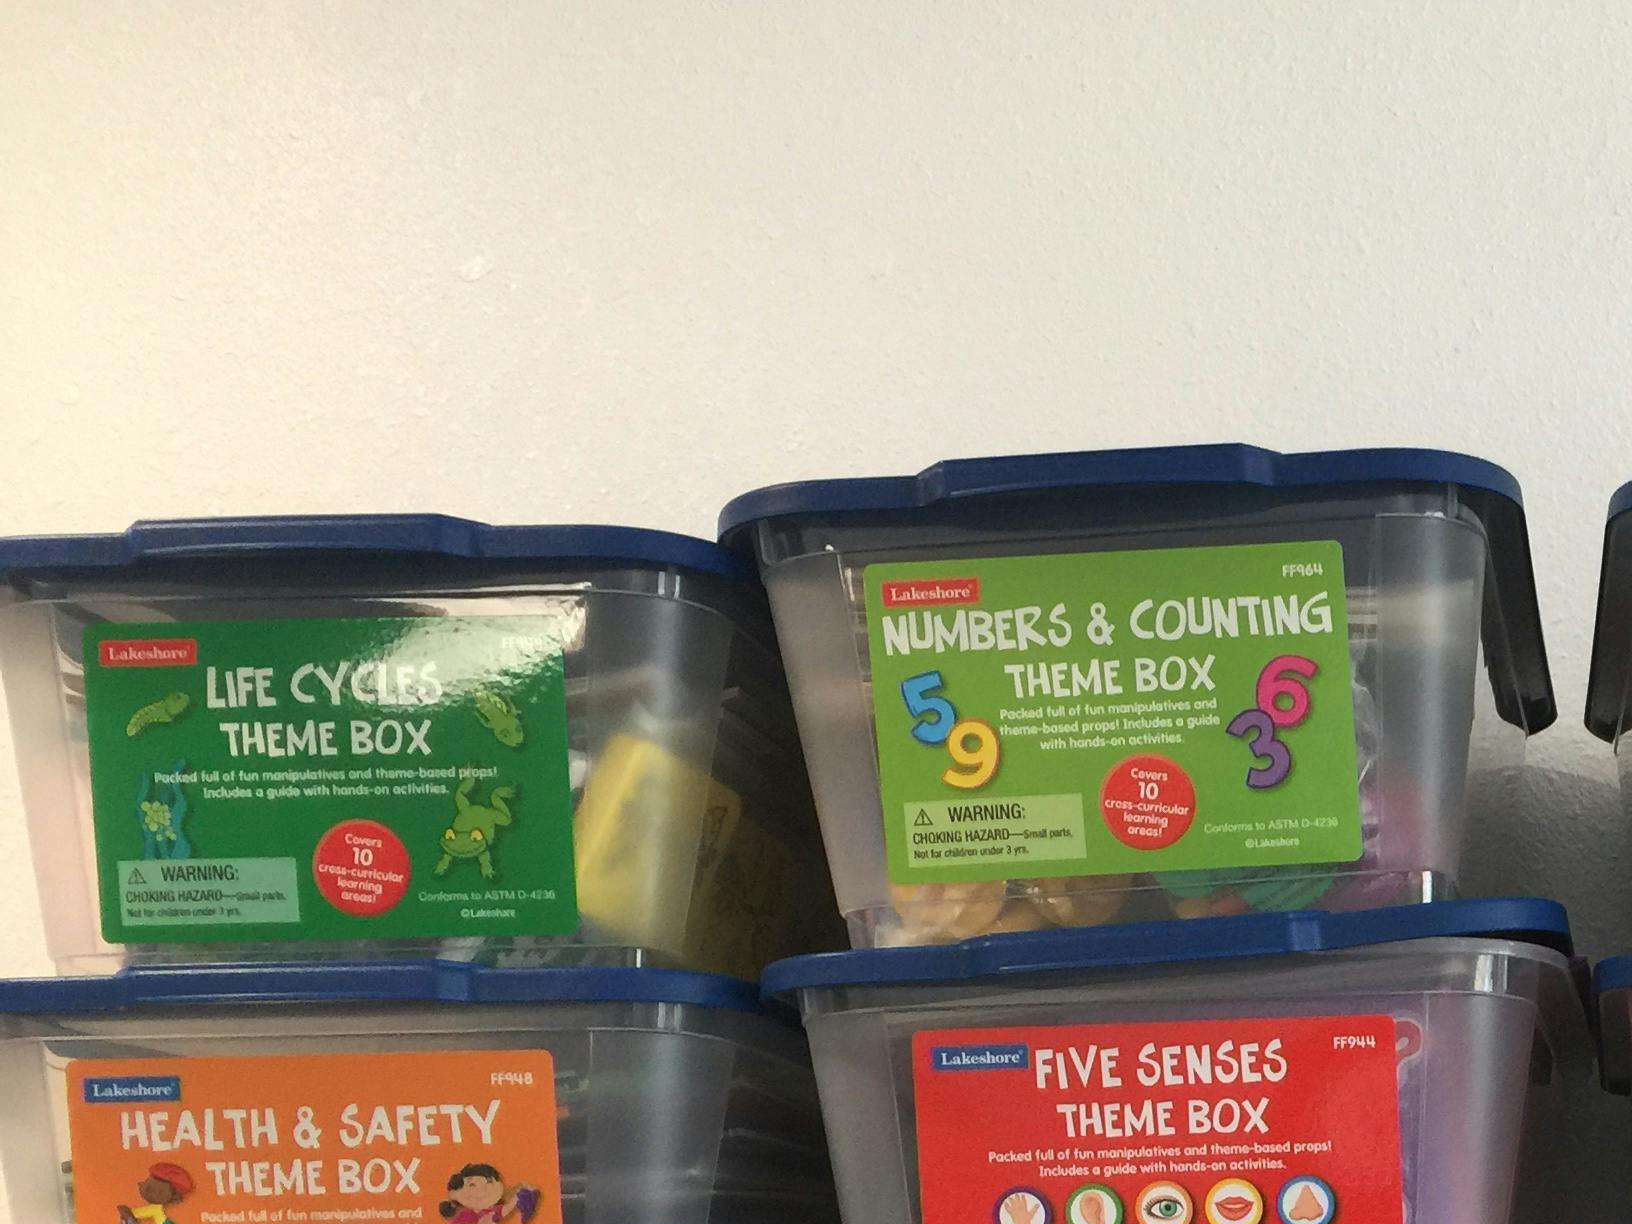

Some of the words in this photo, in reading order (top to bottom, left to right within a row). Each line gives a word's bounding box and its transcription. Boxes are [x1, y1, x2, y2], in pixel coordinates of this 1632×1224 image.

[1282, 563, 1323, 577] FF964
[890, 585, 971, 601] Lakeshore
[882, 604, 1072, 655] NUMBERS
[1087, 603, 1115, 644] &
[1130, 592, 1333, 639] COUNTING
[109, 646, 188, 659] Lakeshore
[207, 666, 276, 709] LIFE
[291, 661, 443, 705] CYCLES
[1005, 660, 1123, 698] THEME
[1136, 655, 1216, 693] BOX
[1256, 655, 1318, 726] 6
[901, 670, 956, 743] 5
[220, 720, 337, 757] THEME
[351, 720, 432, 755] BOX
[943, 718, 1000, 788] 9
[1226, 709, 1292, 788] 3
[948, 803, 1025, 823] WARNING:
[161, 865, 239, 882] WARNING:
[941, 1050, 1020, 1065] Lakeshore
[1333, 1035, 1376, 1048] FF944
[1035, 1044, 1121, 1089] FIVE
[1137, 1039, 1287, 1087] SENSES
[93, 1082, 172, 1097] Lakeshore
[120, 1107, 278, 1152] HEALTH
[294, 1106, 321, 1149] &
[340, 1100, 500, 1148] SAFETY
[1057, 1100, 1175, 1138] THEME
[1189, 1097, 1269, 1134] BOX
[206, 1160, 325, 1197] THEME
[339, 1158, 421, 1195] BOX
[1039, 1163, 1088, 1177] Includes
[1091, 1166, 1100, 1175] a
[1103, 1162, 1136, 1177] guide
[1139, 1160, 1164, 1173] with
[1169, 1159, 1226, 1173] hands-on
[1229, 1158, 1285, 1171] activities.
